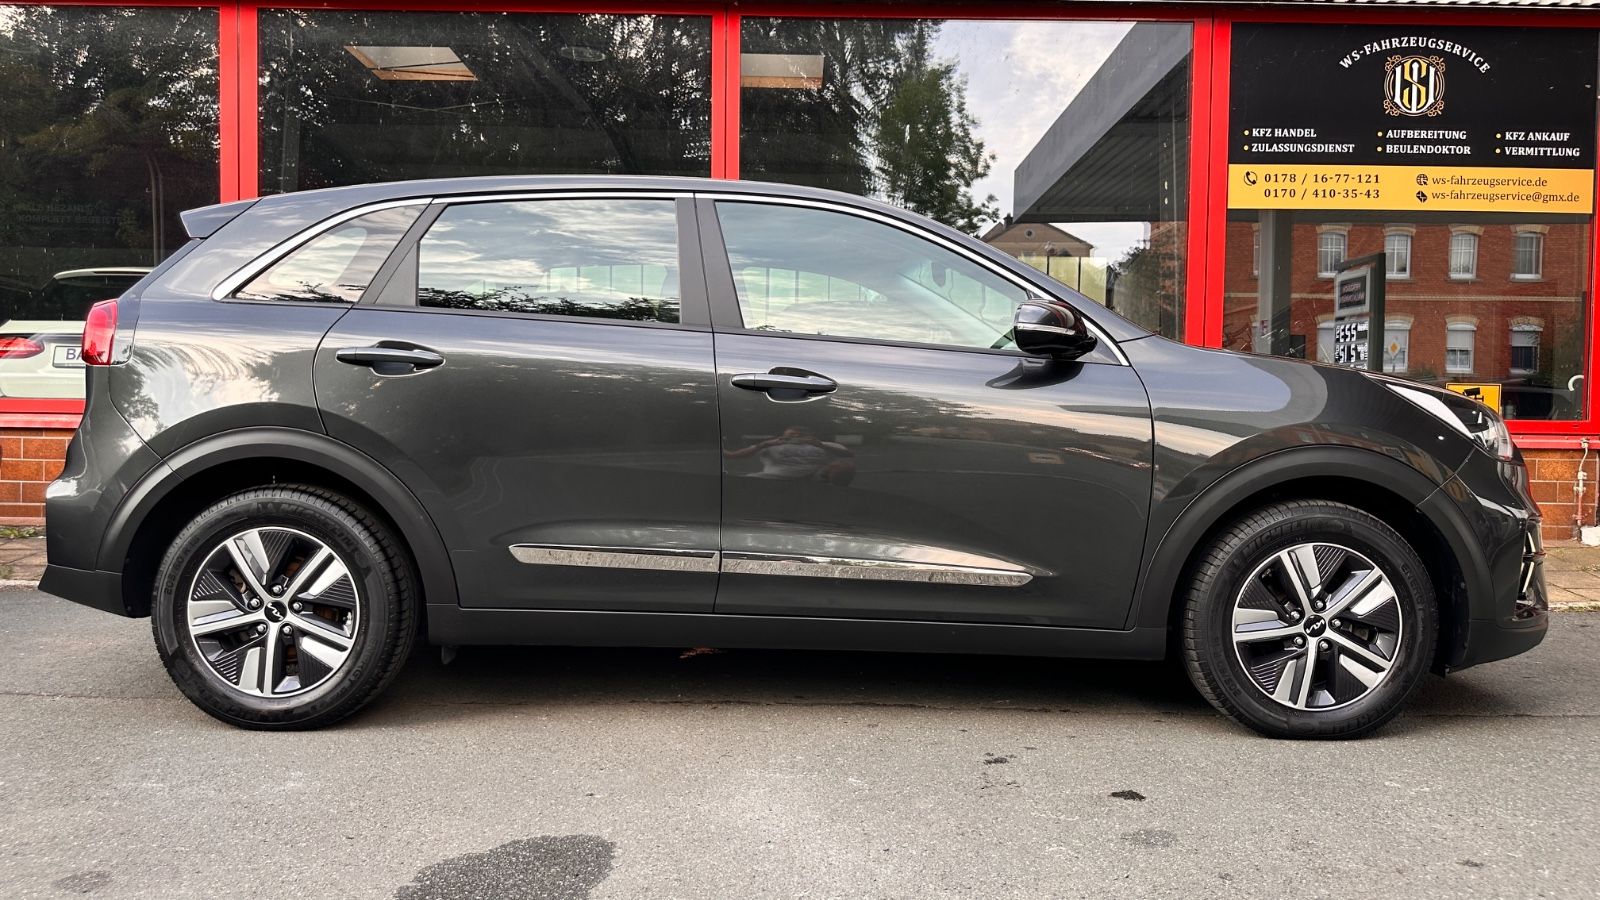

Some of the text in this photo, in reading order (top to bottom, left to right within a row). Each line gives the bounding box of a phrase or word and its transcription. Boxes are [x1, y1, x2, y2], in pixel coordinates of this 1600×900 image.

[1339, 36, 1491, 74] WS-FAHRZEUGSERVICE
[1252, 128, 1317, 138] KFZ HANDEL
[1386, 129, 1467, 140] AUFBEREITUNG
[1505, 131, 1570, 142] KFZ ANKAUF
[1251, 143, 1355, 153] ZULASSUNGSDIENST
[1386, 144, 1471, 155] BEULENDOKTOR
[1505, 146, 1580, 157] VERMITTLUNG
[1264, 173, 1380, 185] 0178 / 16-77-121
[1431, 173, 1548, 188] ws-fahrzeugservice.de
[1264, 188, 1380, 200] 0170 / 410-35-43
[1431, 189, 1580, 204] ws-fahrzeugservice@gmx.de
